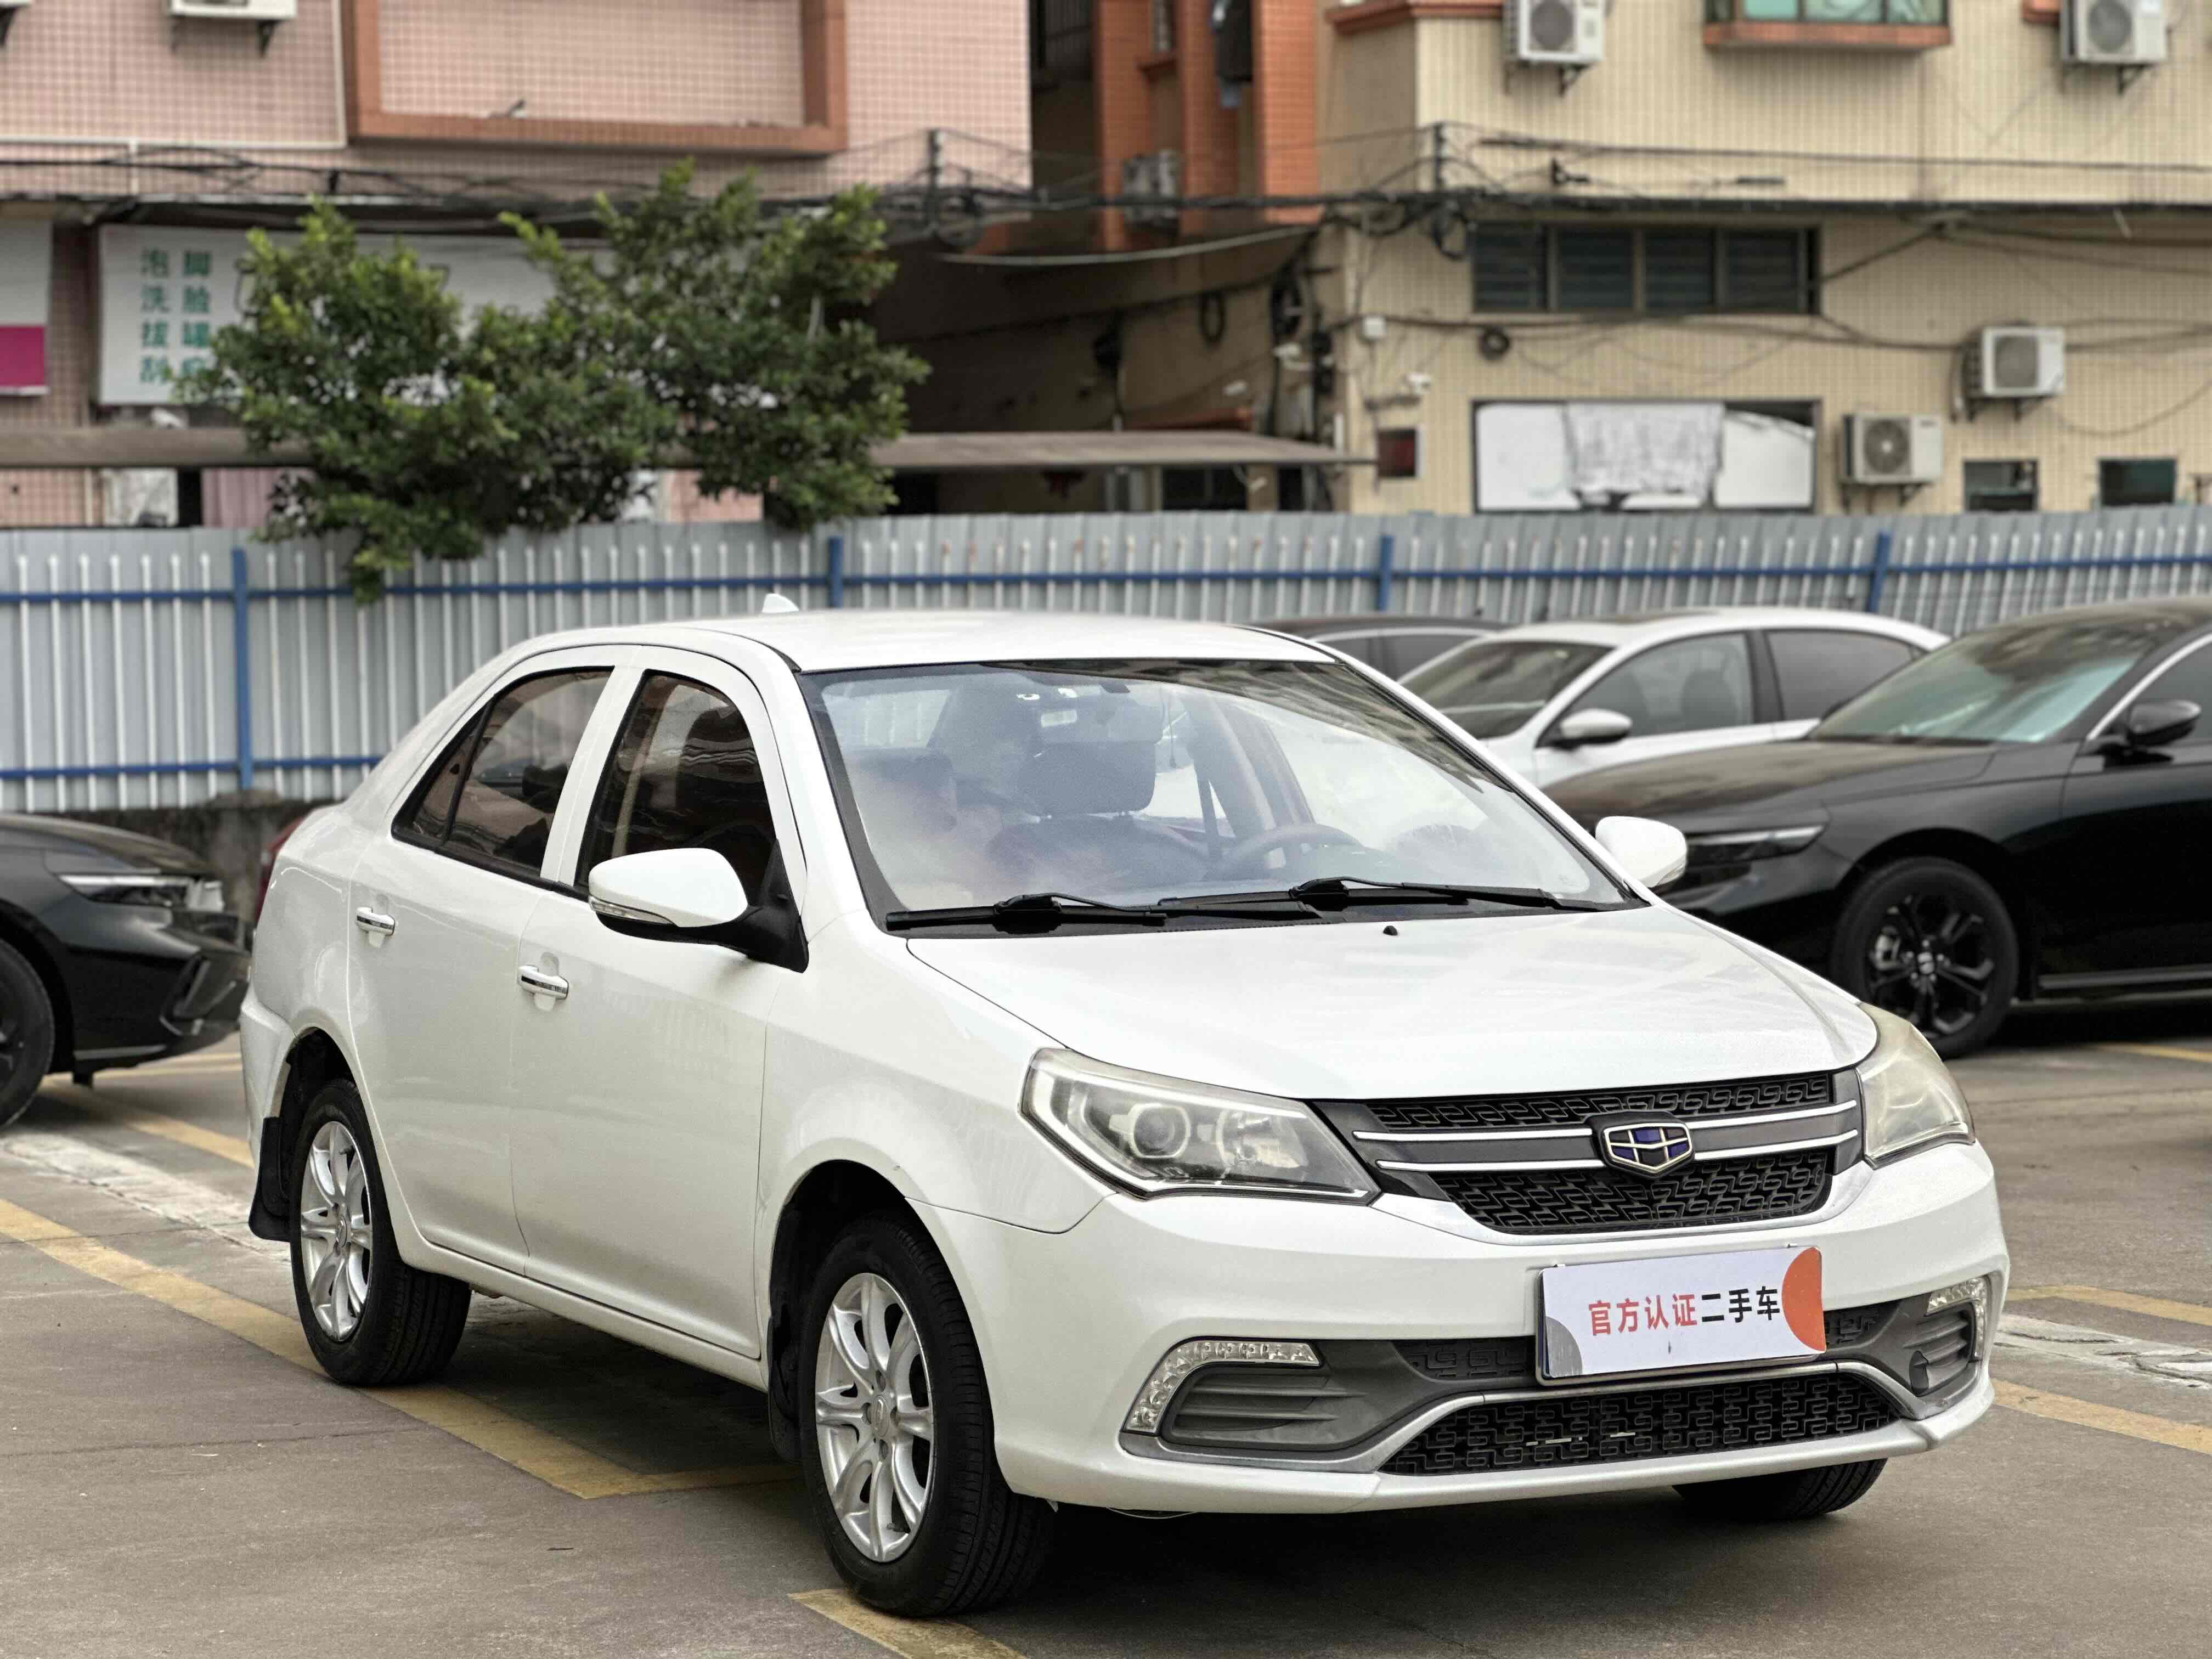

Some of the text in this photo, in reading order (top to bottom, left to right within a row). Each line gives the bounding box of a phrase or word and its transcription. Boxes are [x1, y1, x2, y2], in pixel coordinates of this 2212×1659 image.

[1588, 1285, 1780, 1336] 官方认证二手车
